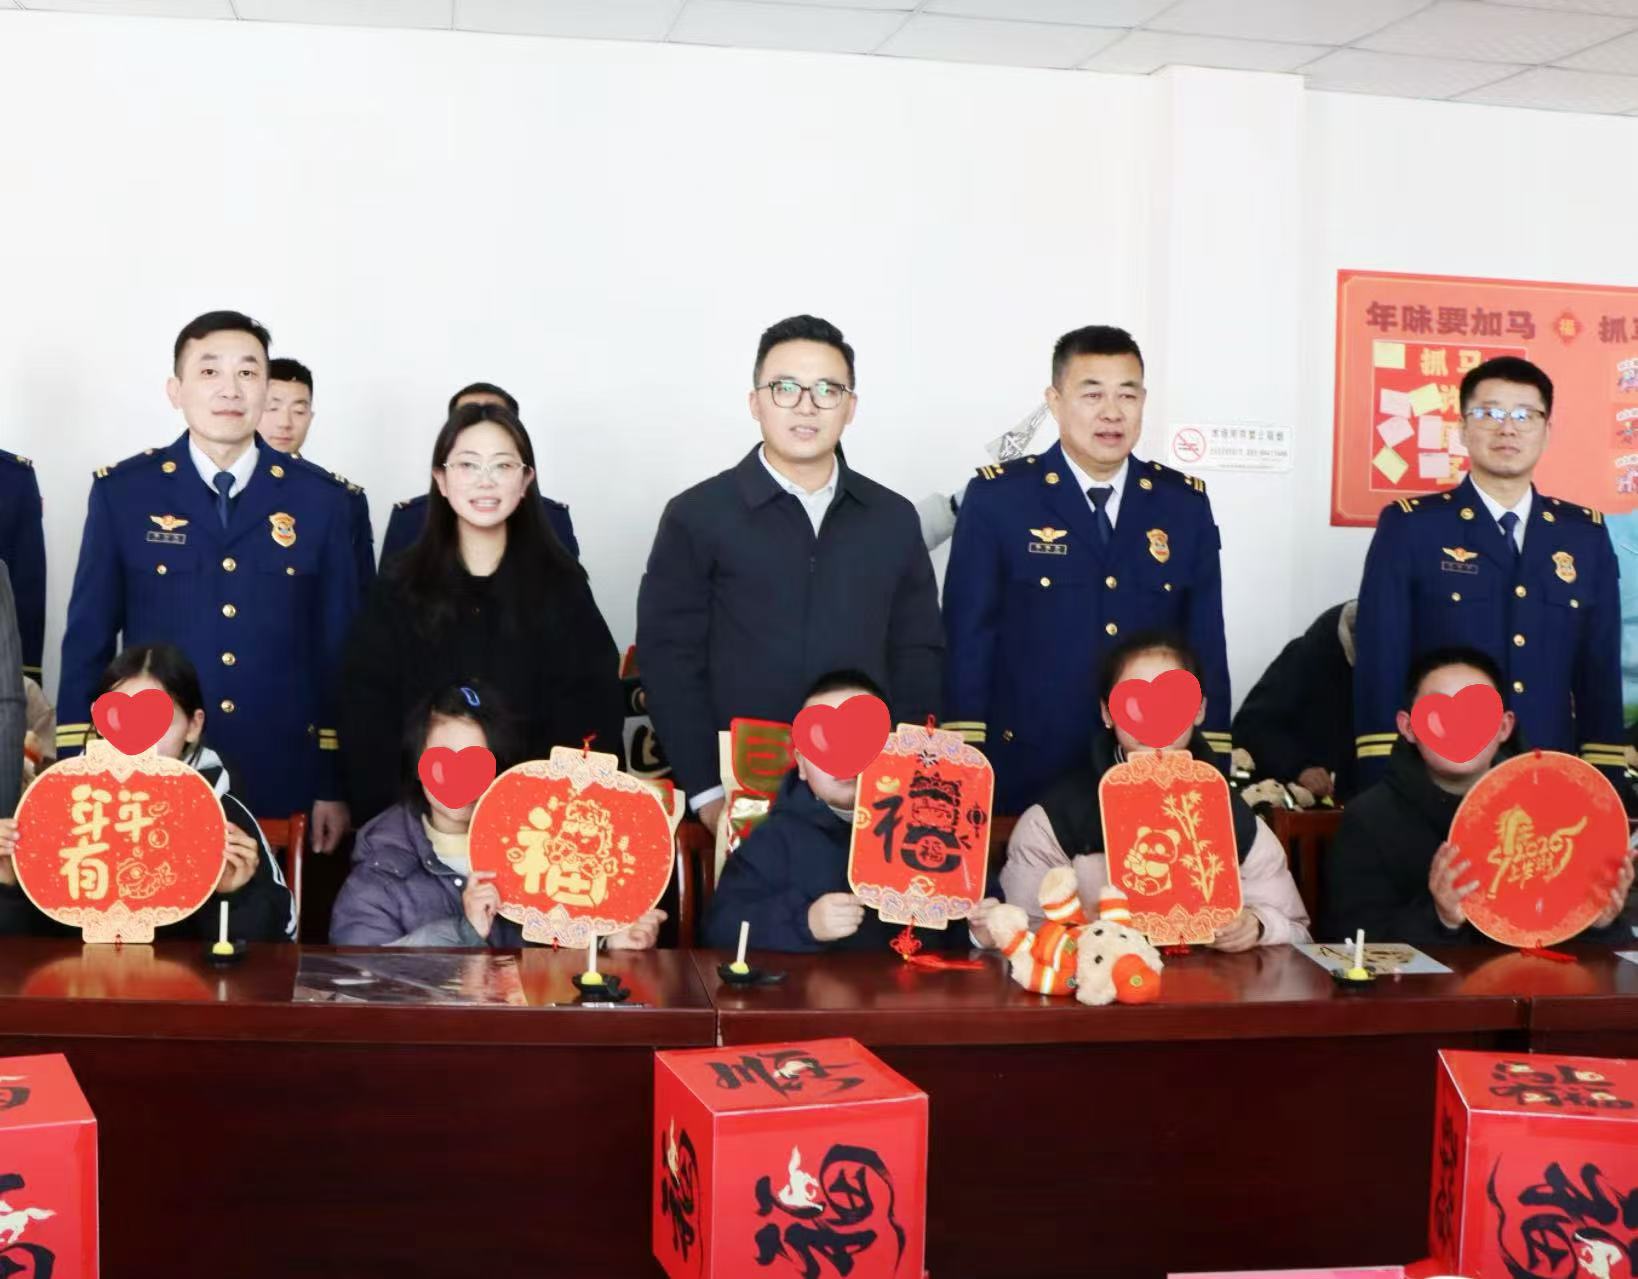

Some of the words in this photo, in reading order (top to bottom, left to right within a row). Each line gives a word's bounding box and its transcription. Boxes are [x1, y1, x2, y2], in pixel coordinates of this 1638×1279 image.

[1366, 302, 1536, 340] 年味要加马
[1598, 316, 1638, 344] 抓
